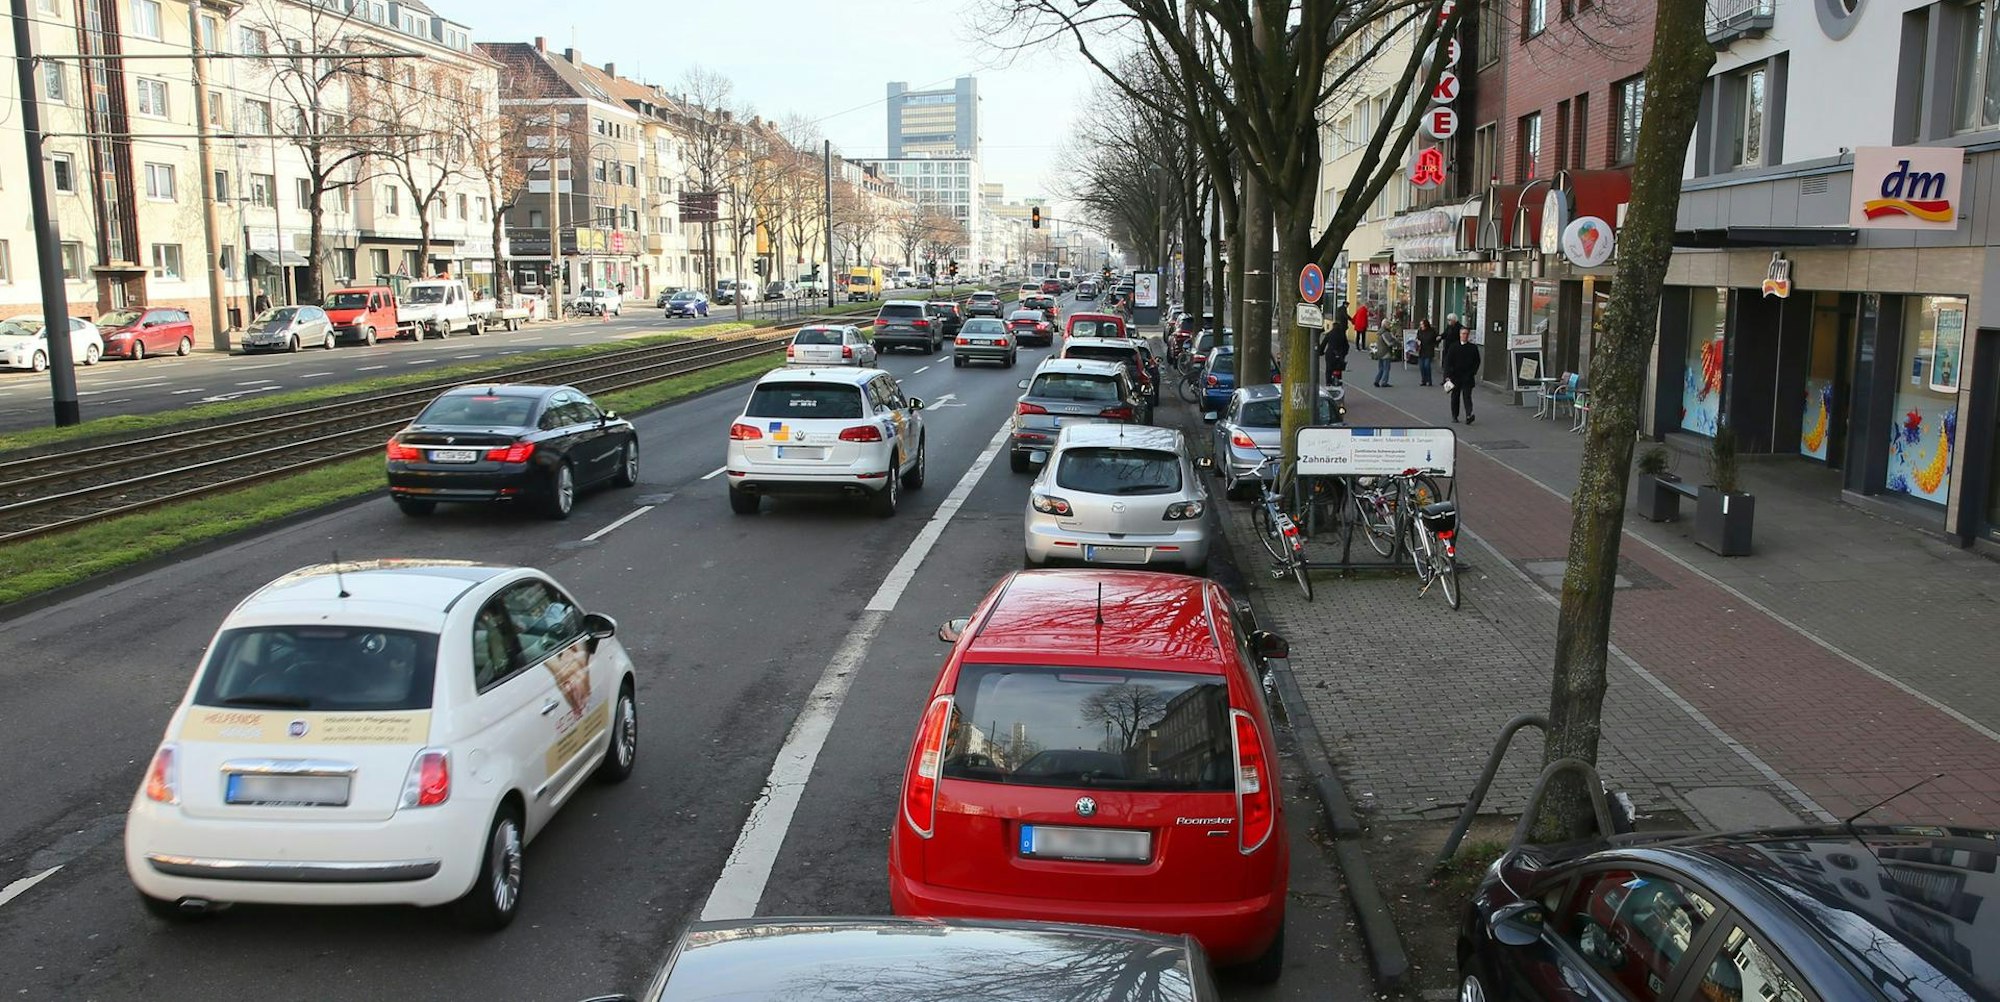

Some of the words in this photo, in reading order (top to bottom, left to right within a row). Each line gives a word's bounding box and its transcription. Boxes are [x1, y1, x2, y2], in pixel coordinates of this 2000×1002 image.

[1881, 160, 1946, 199] dm
[1768, 252, 1788, 281] dm
[1302, 455, 1348, 464] Zahnärzte
[1176, 816, 1235, 825] Roomster
